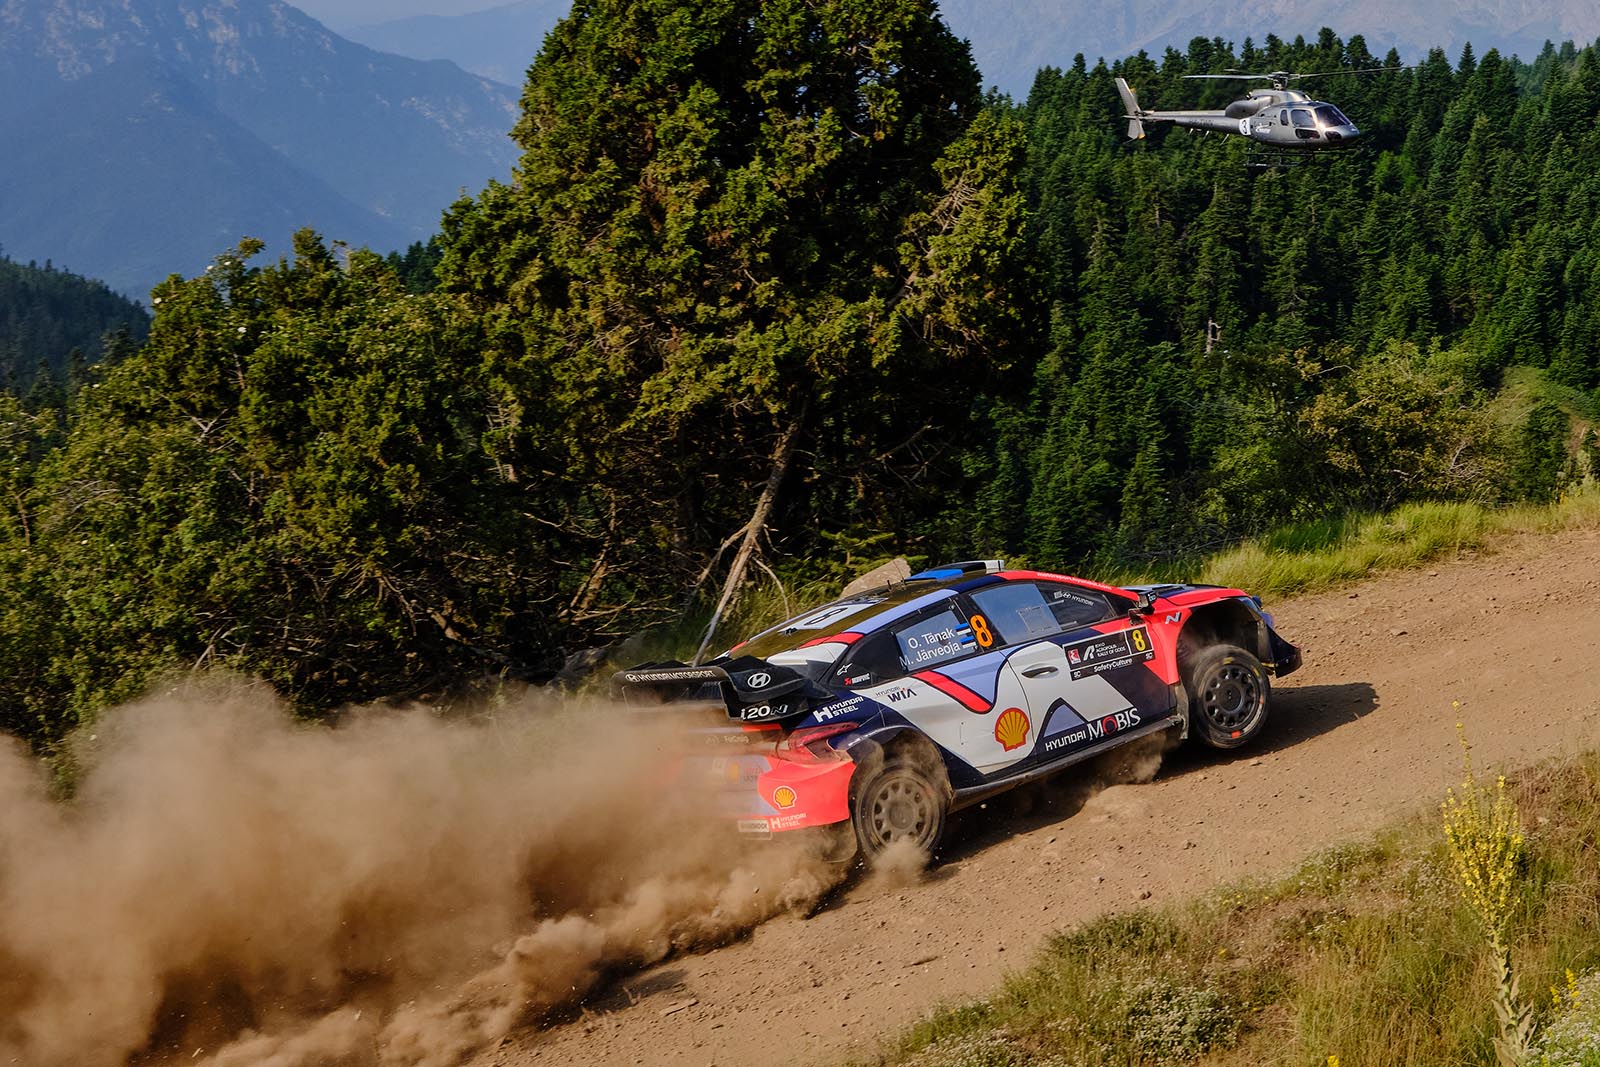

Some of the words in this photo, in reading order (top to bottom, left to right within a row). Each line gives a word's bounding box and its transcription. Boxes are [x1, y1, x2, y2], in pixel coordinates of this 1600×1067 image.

[1072, 595, 1095, 607] HYUNDAI
[908, 637, 922, 649] O.
[921, 628, 955, 646] Tänak
[970, 614, 993, 647] 8
[1132, 629, 1146, 652] 8
[915, 641, 961, 663] Järveoja
[1093, 658, 1133, 673] SafetyCulture
[638, 671, 672, 682] HYUNDAI
[670, 670, 717, 680] MOTORSPORT
[888, 687, 918, 703] WIA
[829, 696, 865, 712] HYUNDAI
[832, 704, 859, 717] STEEL
[1045, 731, 1087, 752] HYUNDAI
[1086, 707, 1142, 741] MOBIS
[780, 812, 807, 822] HYUNDAI
